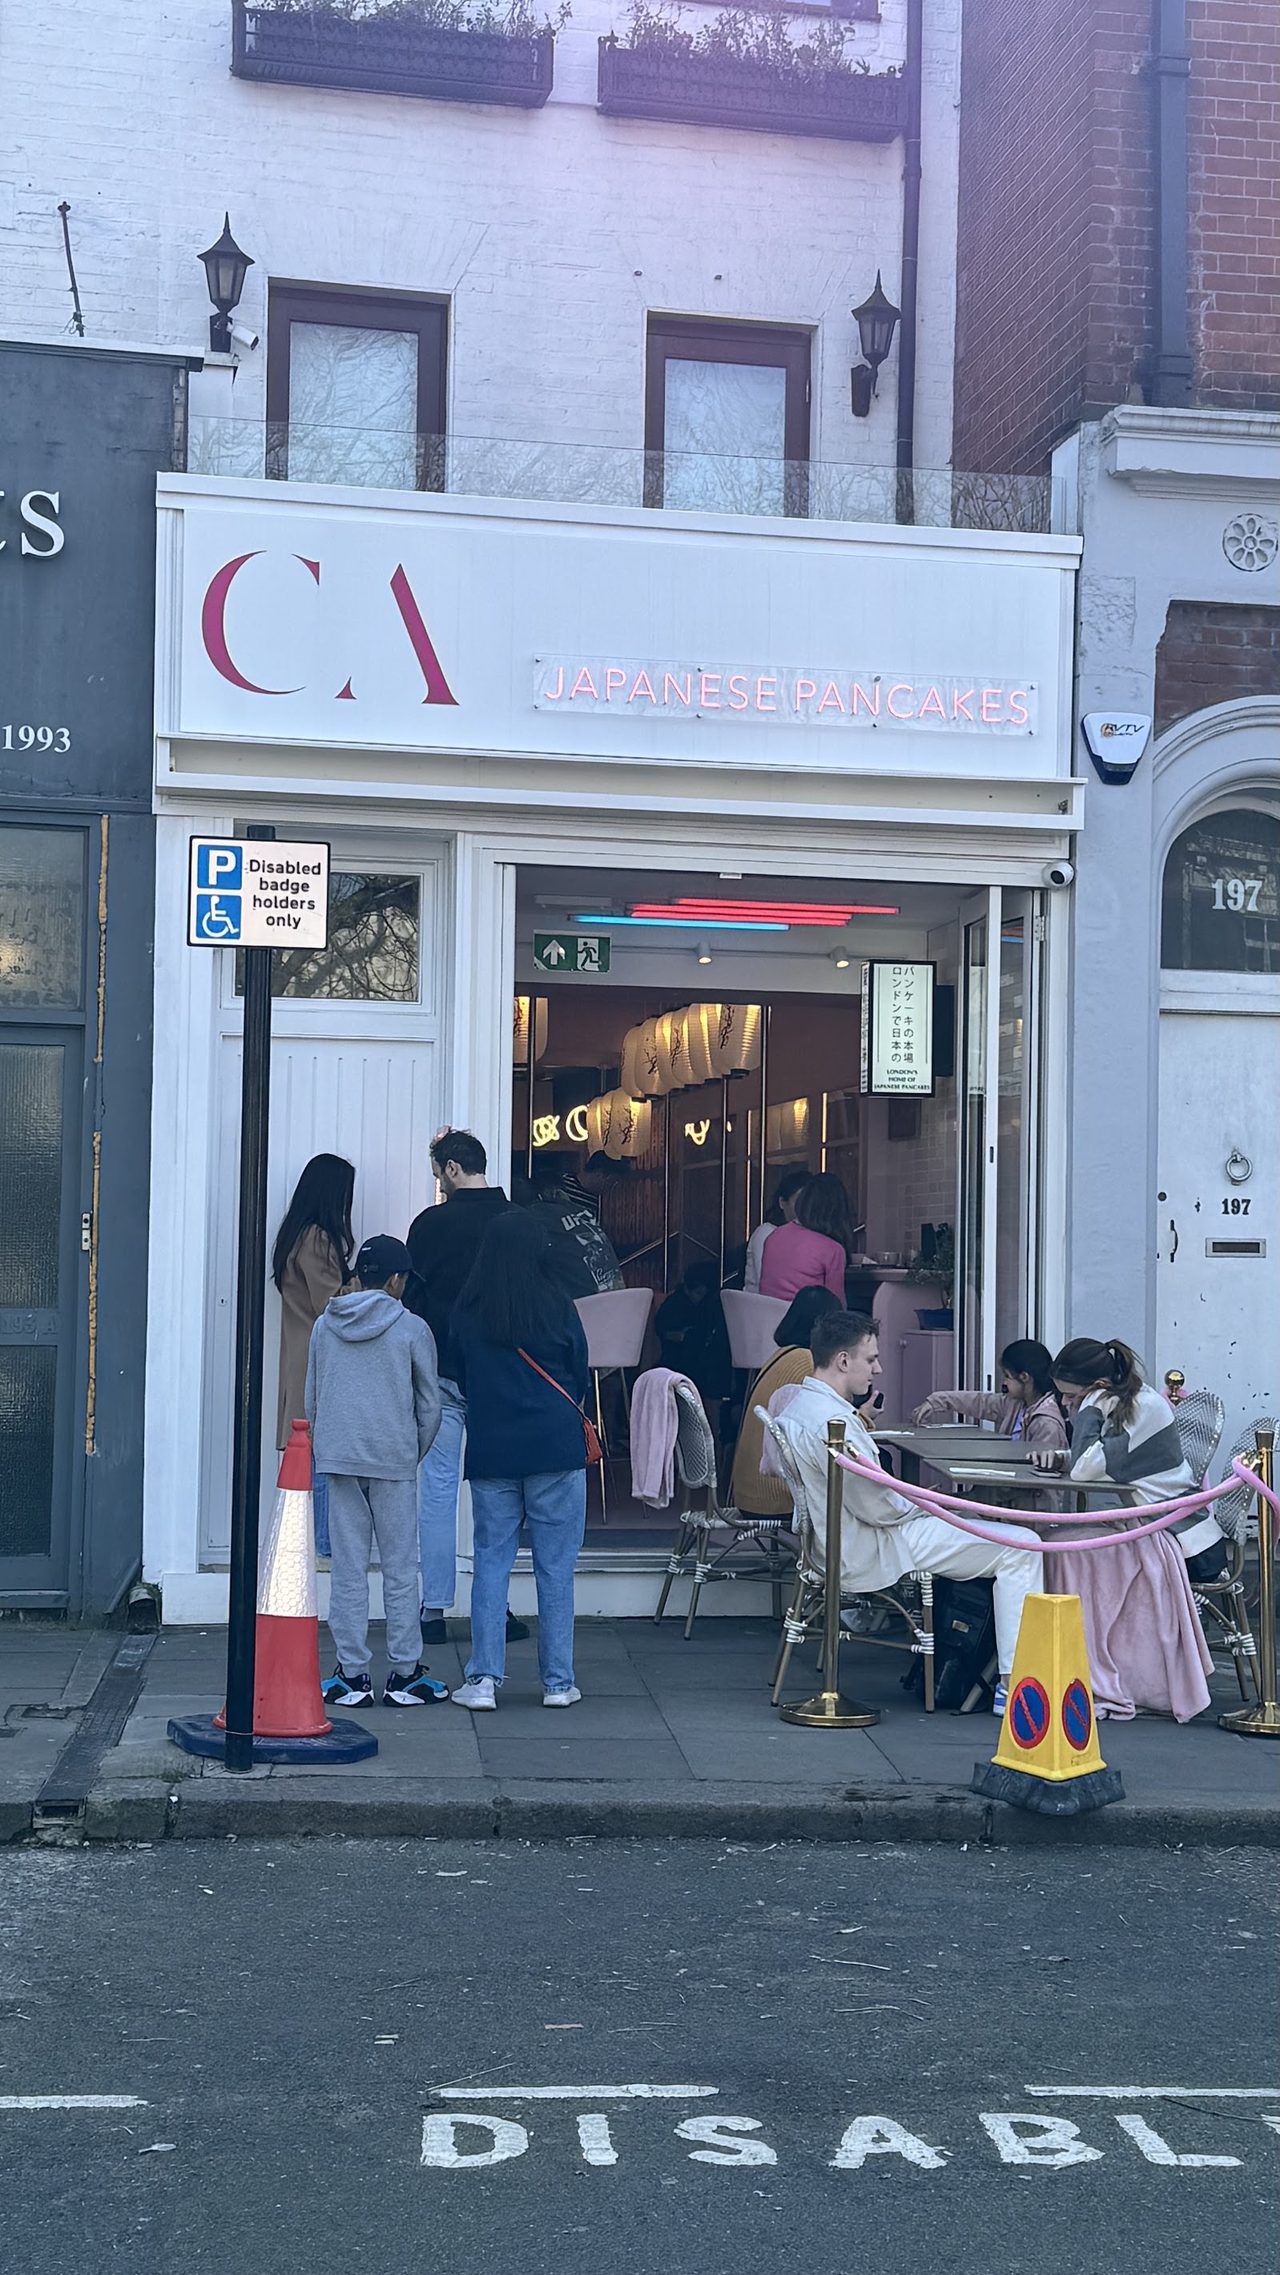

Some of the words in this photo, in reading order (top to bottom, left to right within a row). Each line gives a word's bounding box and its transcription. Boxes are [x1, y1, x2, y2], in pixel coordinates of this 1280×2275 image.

[0, 489, 65, 557] S
[201, 549, 460, 706] CA
[544, 666, 777, 711] JAPANESE
[793, 679, 1029, 725] PANCAKES
[1, 724, 71, 753] 1993
[208, 849, 236, 886] P
[249, 859, 321, 876] Disabled
[259, 877, 310, 895] badge
[1211, 879, 1263, 912] 197
[252, 894, 316, 911] holders
[265, 913, 302, 930] only
[1222, 1198, 1252, 1216] 197
